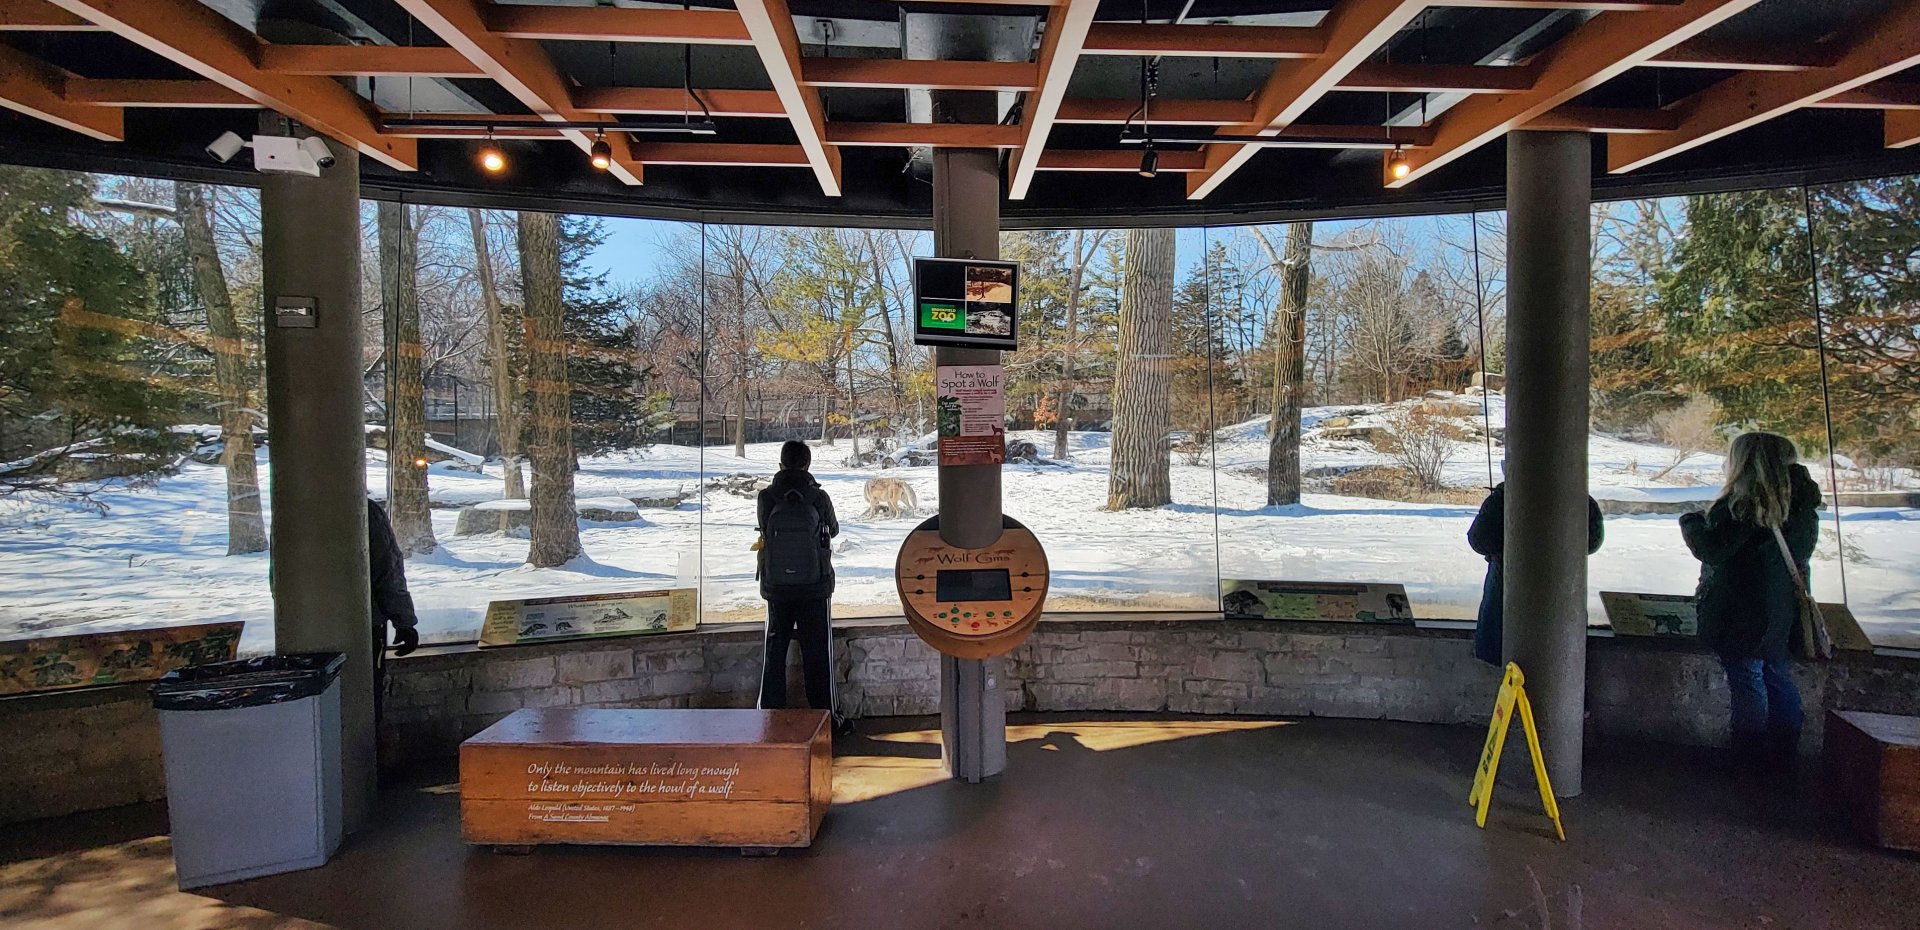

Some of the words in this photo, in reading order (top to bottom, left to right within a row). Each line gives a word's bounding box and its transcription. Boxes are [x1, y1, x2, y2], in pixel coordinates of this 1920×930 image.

[931, 312, 956, 321] ZOO
[955, 370, 975, 379] How
[976, 370, 985, 379] to
[941, 378, 967, 393] Spot
[977, 375, 1000, 387] Wolf
[937, 553, 970, 564] Wolf
[975, 552, 1010, 563] Cams
[528, 761, 552, 779] Only
[555, 761, 572, 774] the
[574, 763, 625, 774] mountain
[628, 762, 648, 775] has
[650, 762, 677, 775] lived
[677, 762, 699, 780] long
[701, 762, 739, 781] enough
[528, 781, 538, 792] to
[541, 780, 569, 792] listen
[572, 780, 624, 798] objectively
[626, 781, 637, 792] to
[639, 780, 656, 793] the
[658, 780, 686, 793] howl
[687, 780, 699, 798] of
[699, 785, 705, 793] a
[708, 780, 734, 799] wolf.
